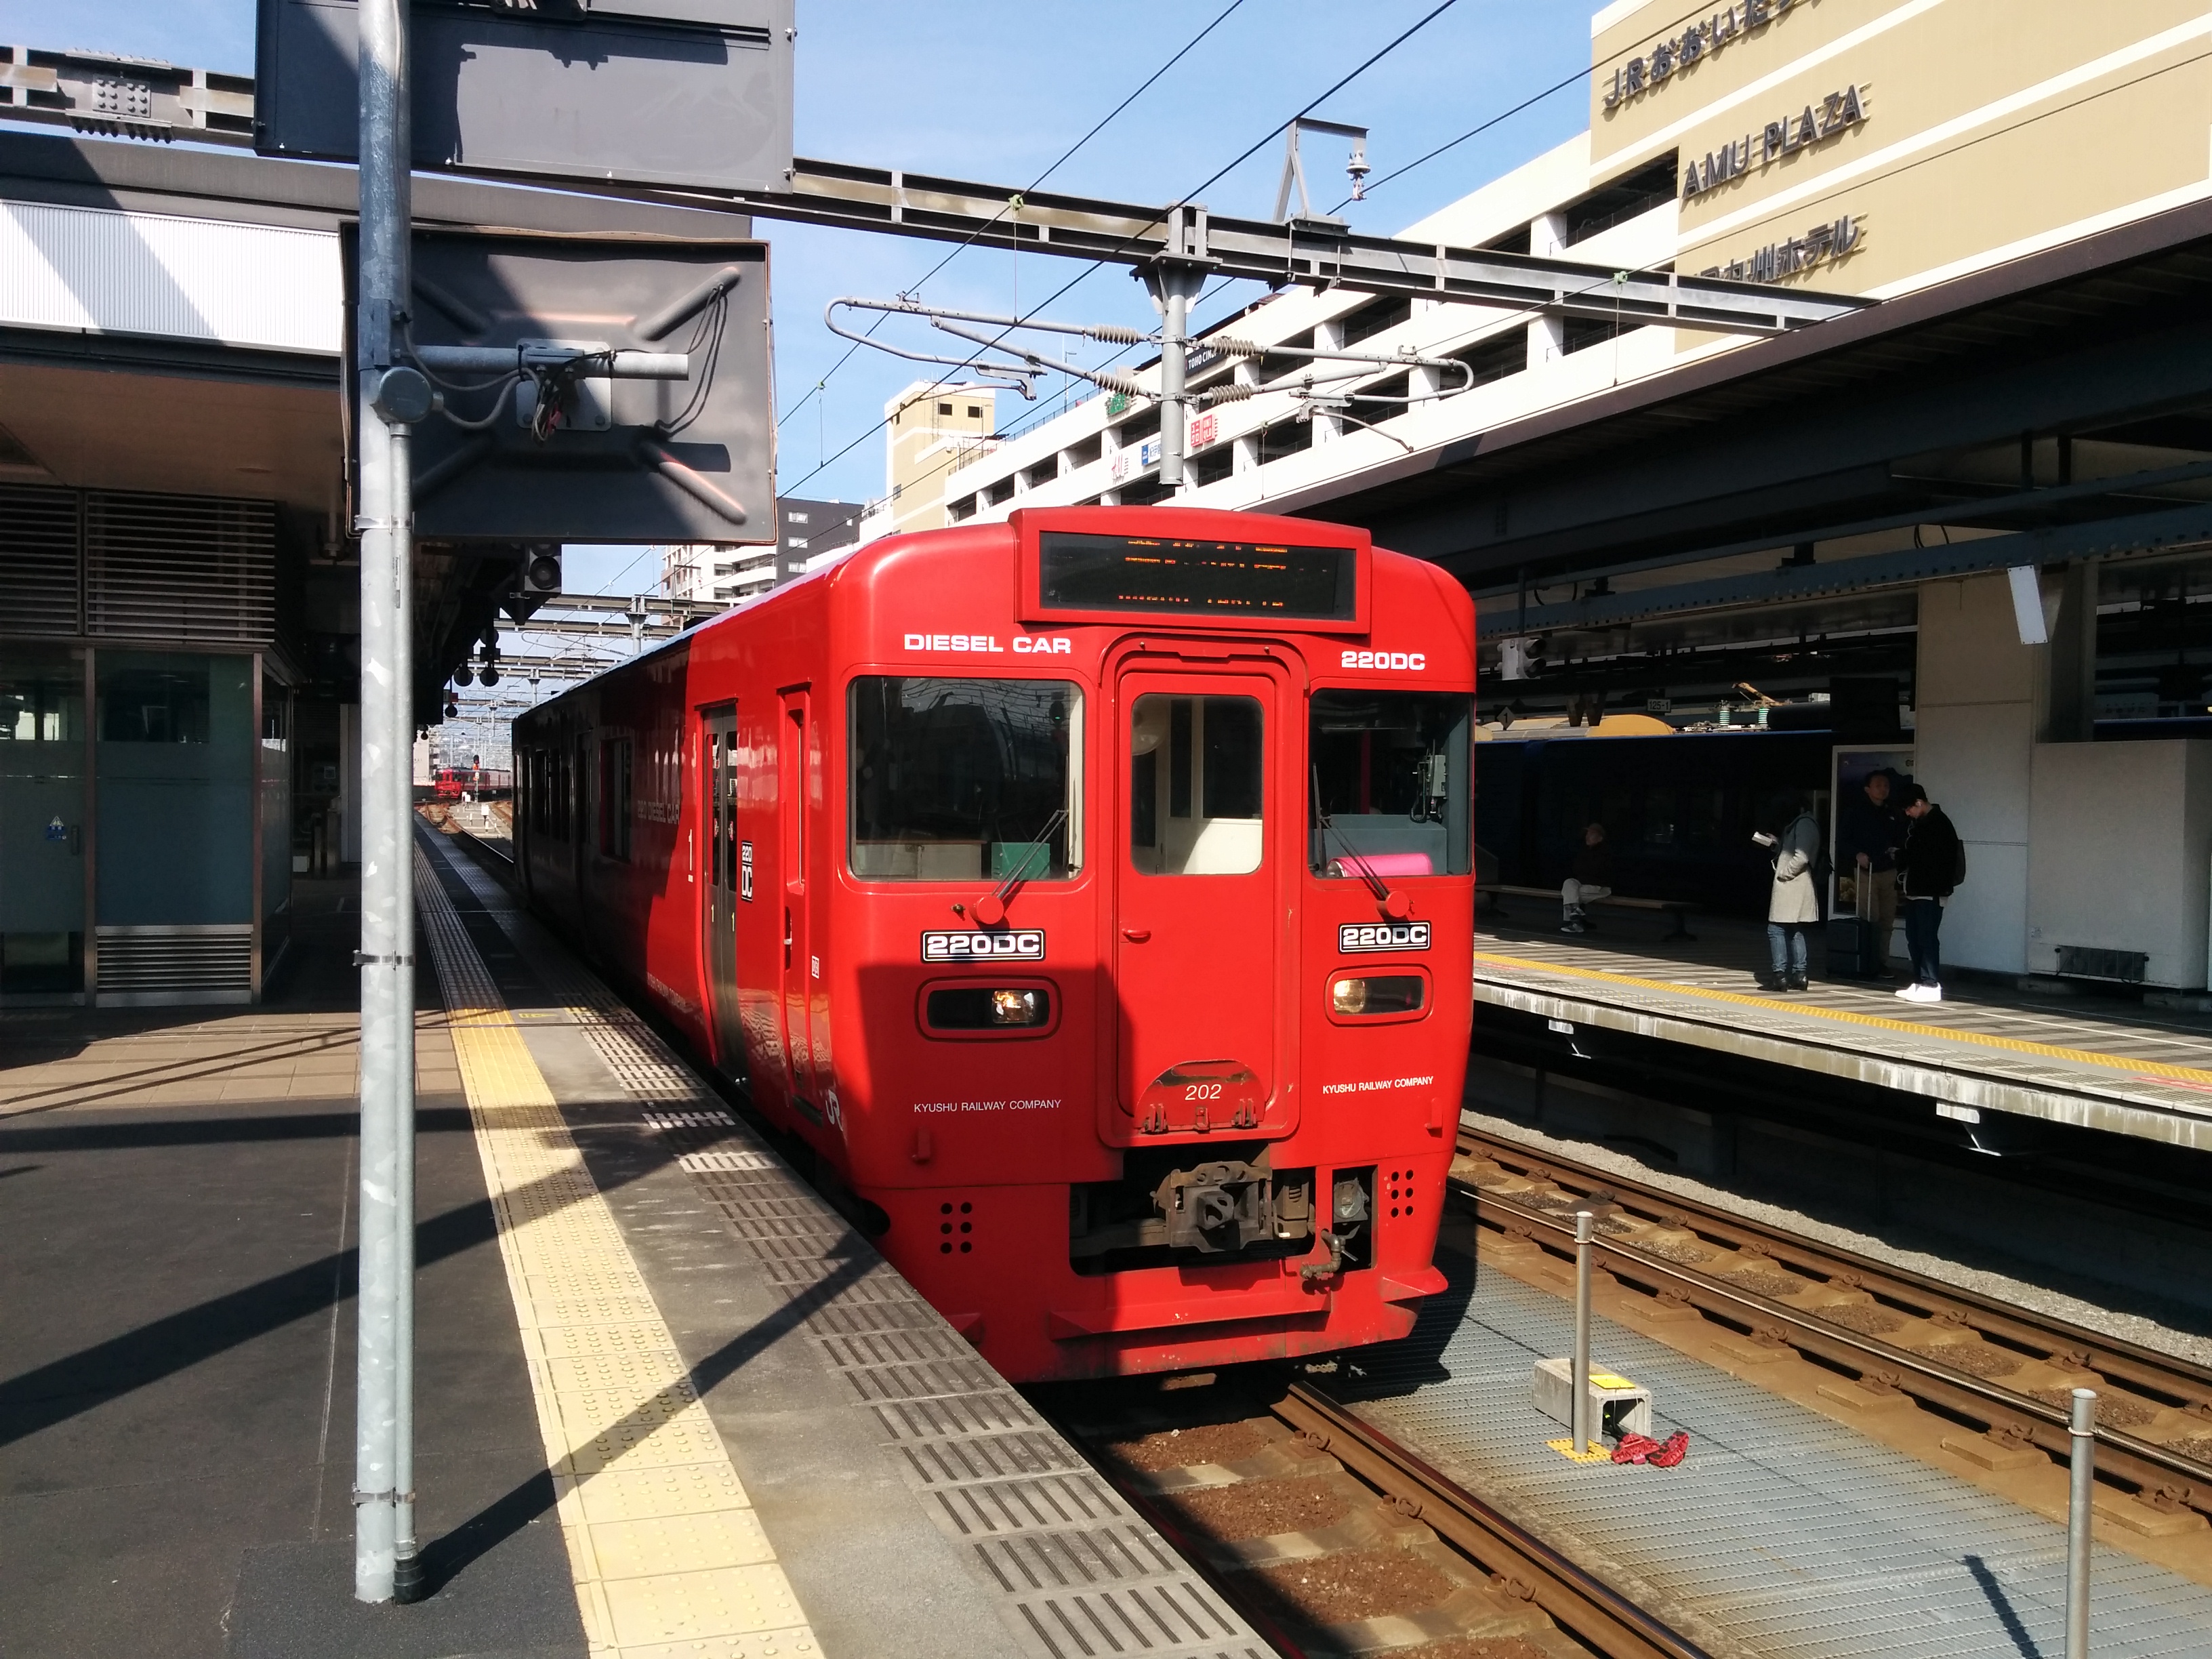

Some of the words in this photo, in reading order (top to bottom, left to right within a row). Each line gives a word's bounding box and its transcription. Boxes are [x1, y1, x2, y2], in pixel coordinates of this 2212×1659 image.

[1604, 0, 1797, 109] JRおおいた
[1682, 133, 1753, 199] AMU
[1763, 83, 1867, 163] PLAZA
[1188, 354, 1202, 370] TOHO
[1203, 416, 1212, 429] UNI
[1203, 426, 1212, 441] QLO
[904, 634, 1004, 653] DIESEL
[1012, 637, 1071, 654] CAR
[1341, 651, 1426, 671] 220DC
[1649, 700, 1668, 711] 125-1
[1503, 712, 1508, 724] 1
[648, 801, 666, 823] DIESEL
[667, 803, 680, 825] CAR
[742, 845, 752, 863] 220
[742, 865, 752, 898] DC
[927, 934, 1040, 954] 220DC
[1343, 926, 1427, 946] 220DC
[1185, 1084, 1222, 1101] 202
[1322, 1083, 1356, 1094] KYUSHU
[1359, 1080, 1393, 1092] RAILWAY
[1395, 1076, 1434, 1088] COMPANY
[825, 1088, 844, 1132] JR
[914, 1103, 958, 1113] KYUSHU
[961, 1101, 1006, 1111] RAILWAY
[1009, 1099, 1061, 1110] COMPANY
